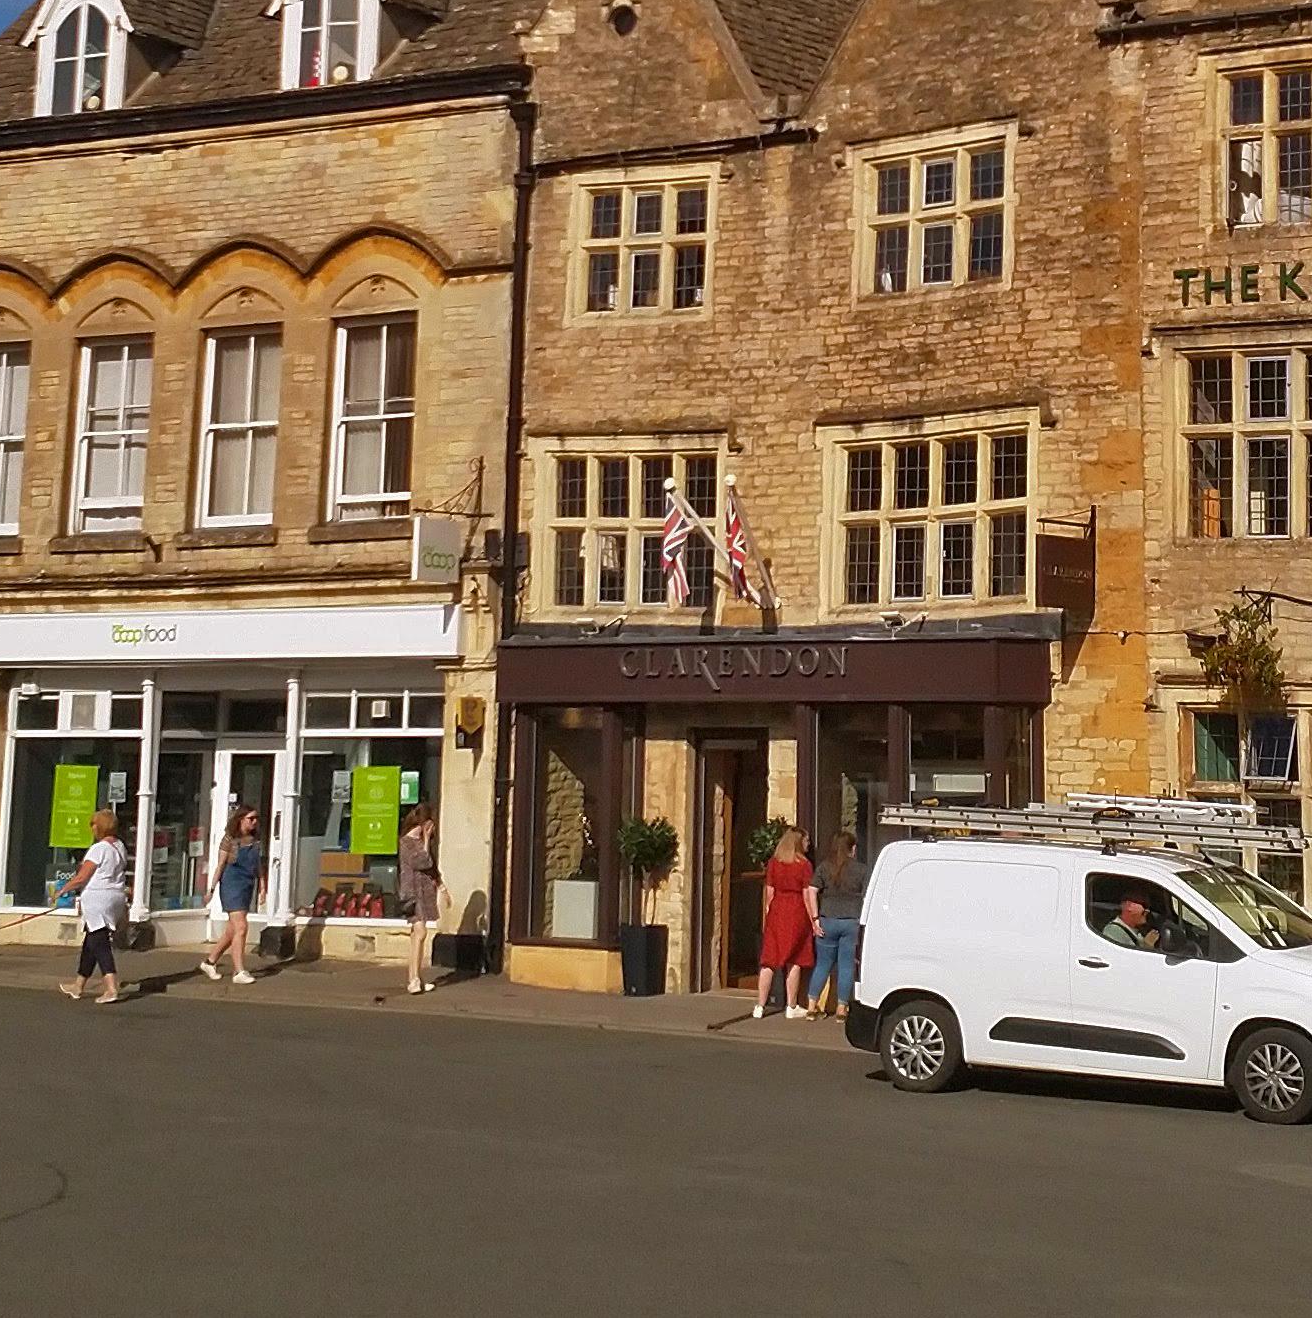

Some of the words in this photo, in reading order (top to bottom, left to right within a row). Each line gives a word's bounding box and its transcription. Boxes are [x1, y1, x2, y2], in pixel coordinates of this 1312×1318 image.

[1173, 264, 1261, 307] THE
[144, 623, 177, 642] food
[620, 645, 849, 691] CLARENDON
